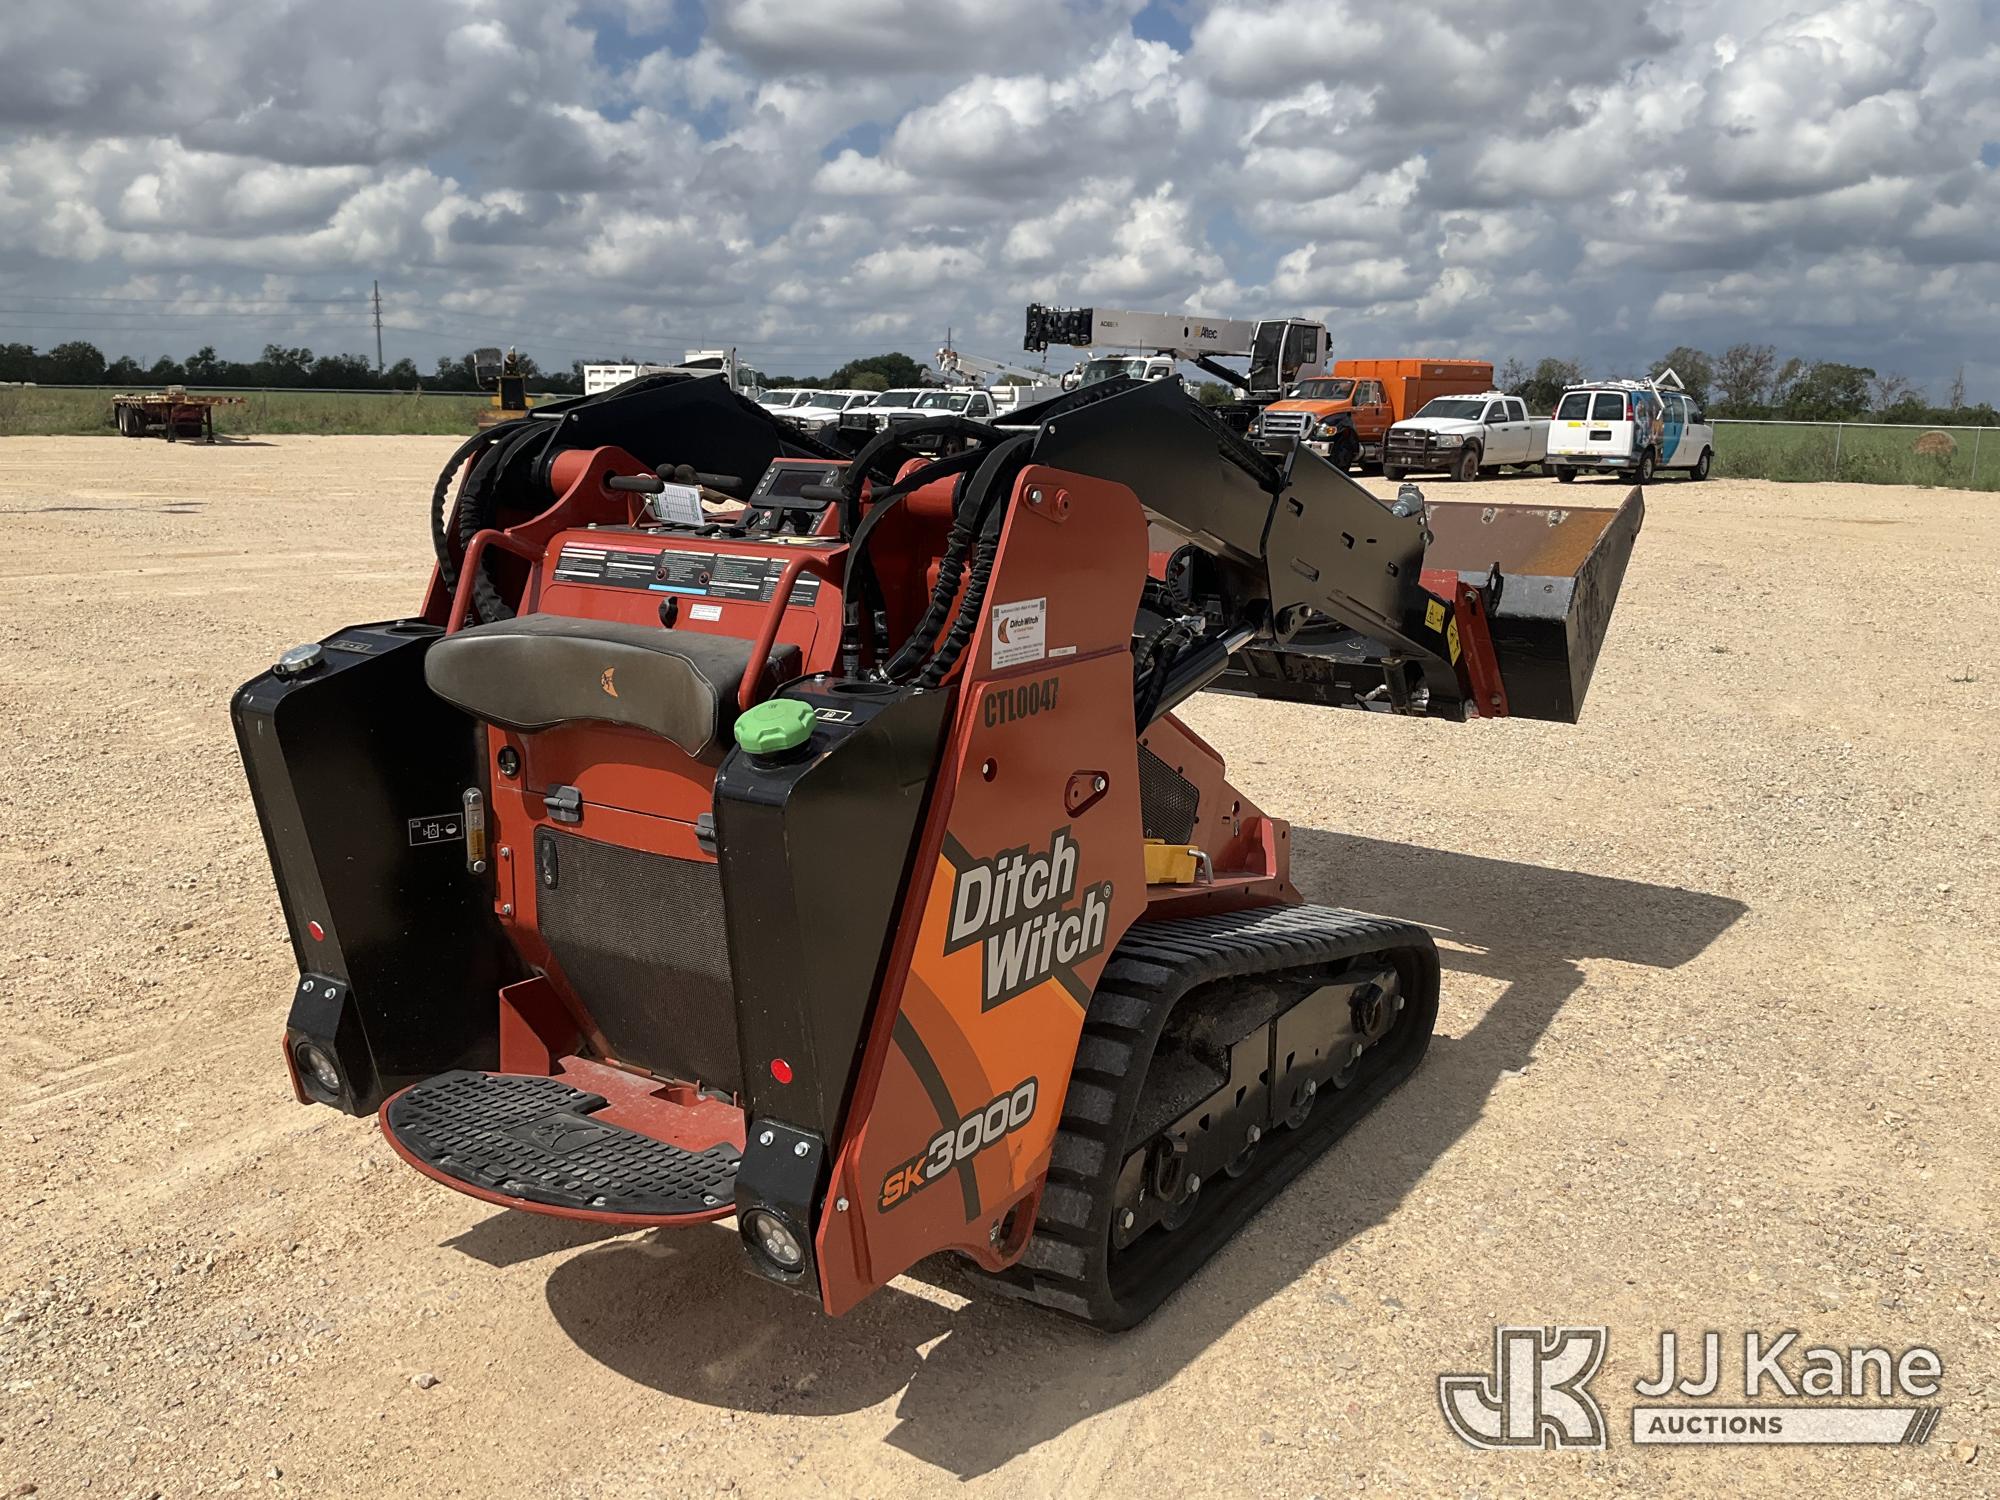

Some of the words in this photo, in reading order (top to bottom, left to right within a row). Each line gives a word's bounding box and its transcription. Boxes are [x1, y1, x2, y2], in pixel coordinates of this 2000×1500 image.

[1200, 326, 1218, 339] Altec
[984, 677, 1059, 728] CTL0047
[951, 835, 1076, 942] Ditch
[882, 1082, 1035, 1207] SK3000
